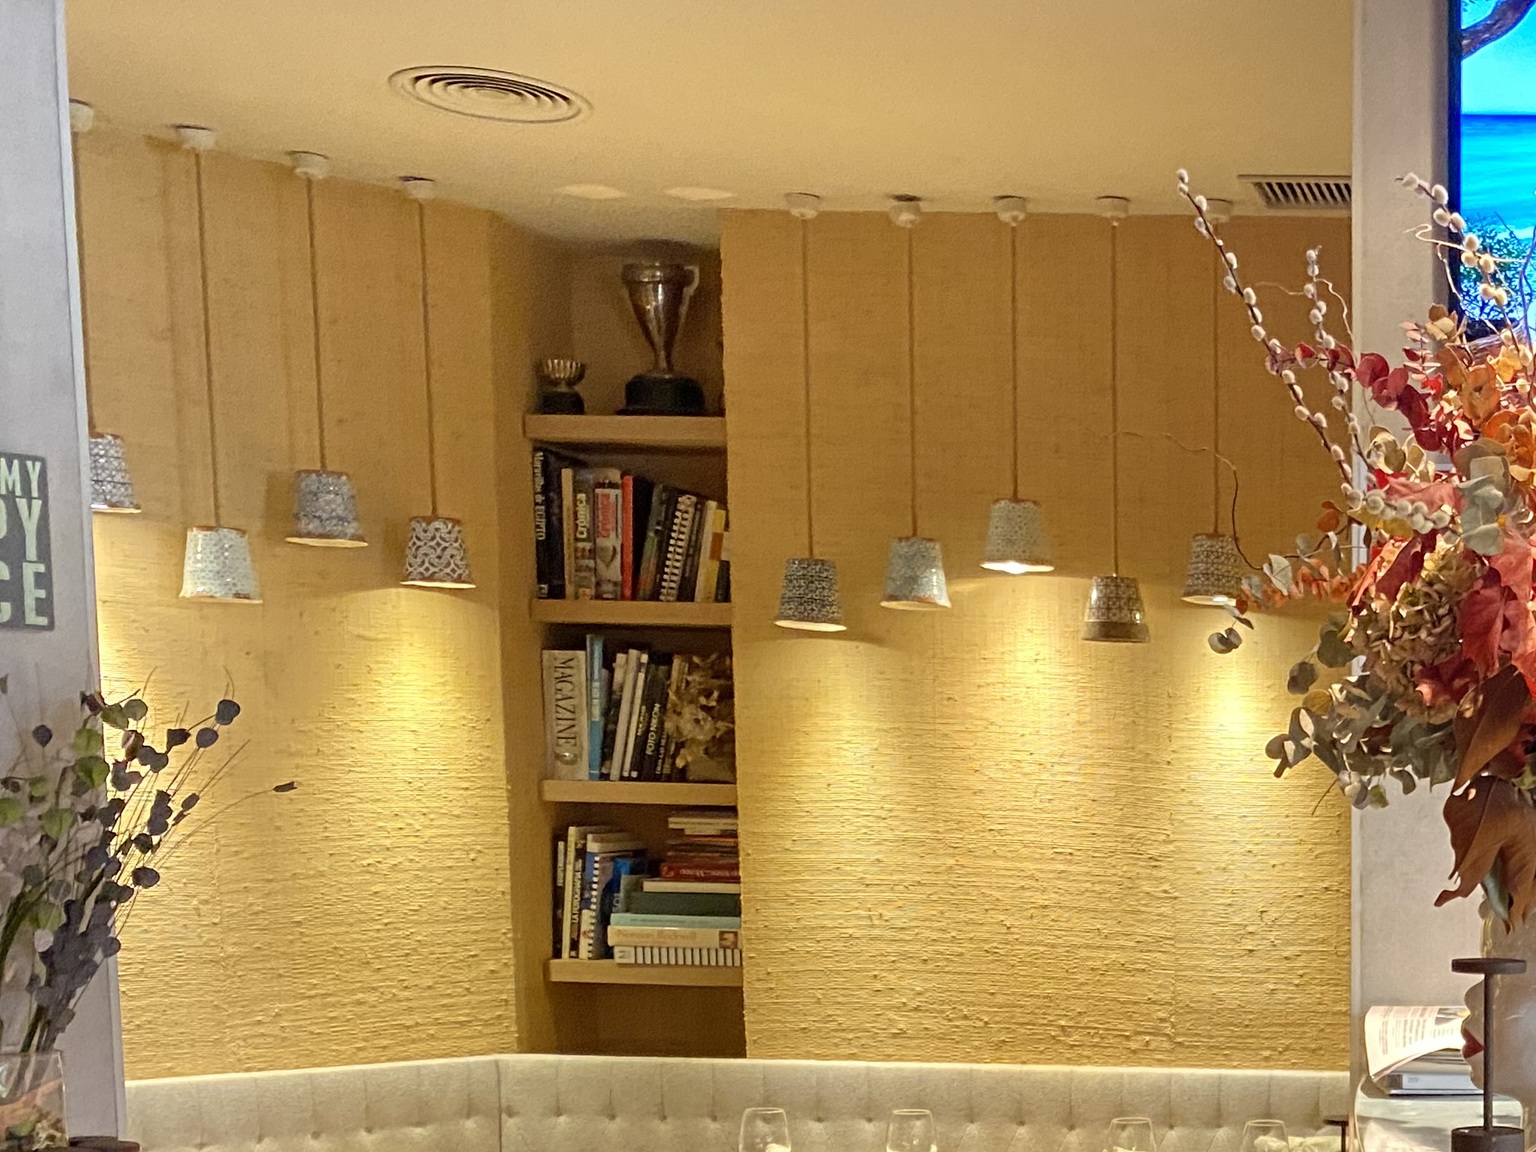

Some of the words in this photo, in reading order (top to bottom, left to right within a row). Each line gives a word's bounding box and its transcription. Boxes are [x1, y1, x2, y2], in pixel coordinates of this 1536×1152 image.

[553, 656, 578, 748] MAGAZINE
[649, 703, 661, 731] NIKON
[646, 732, 656, 755] FOTO
